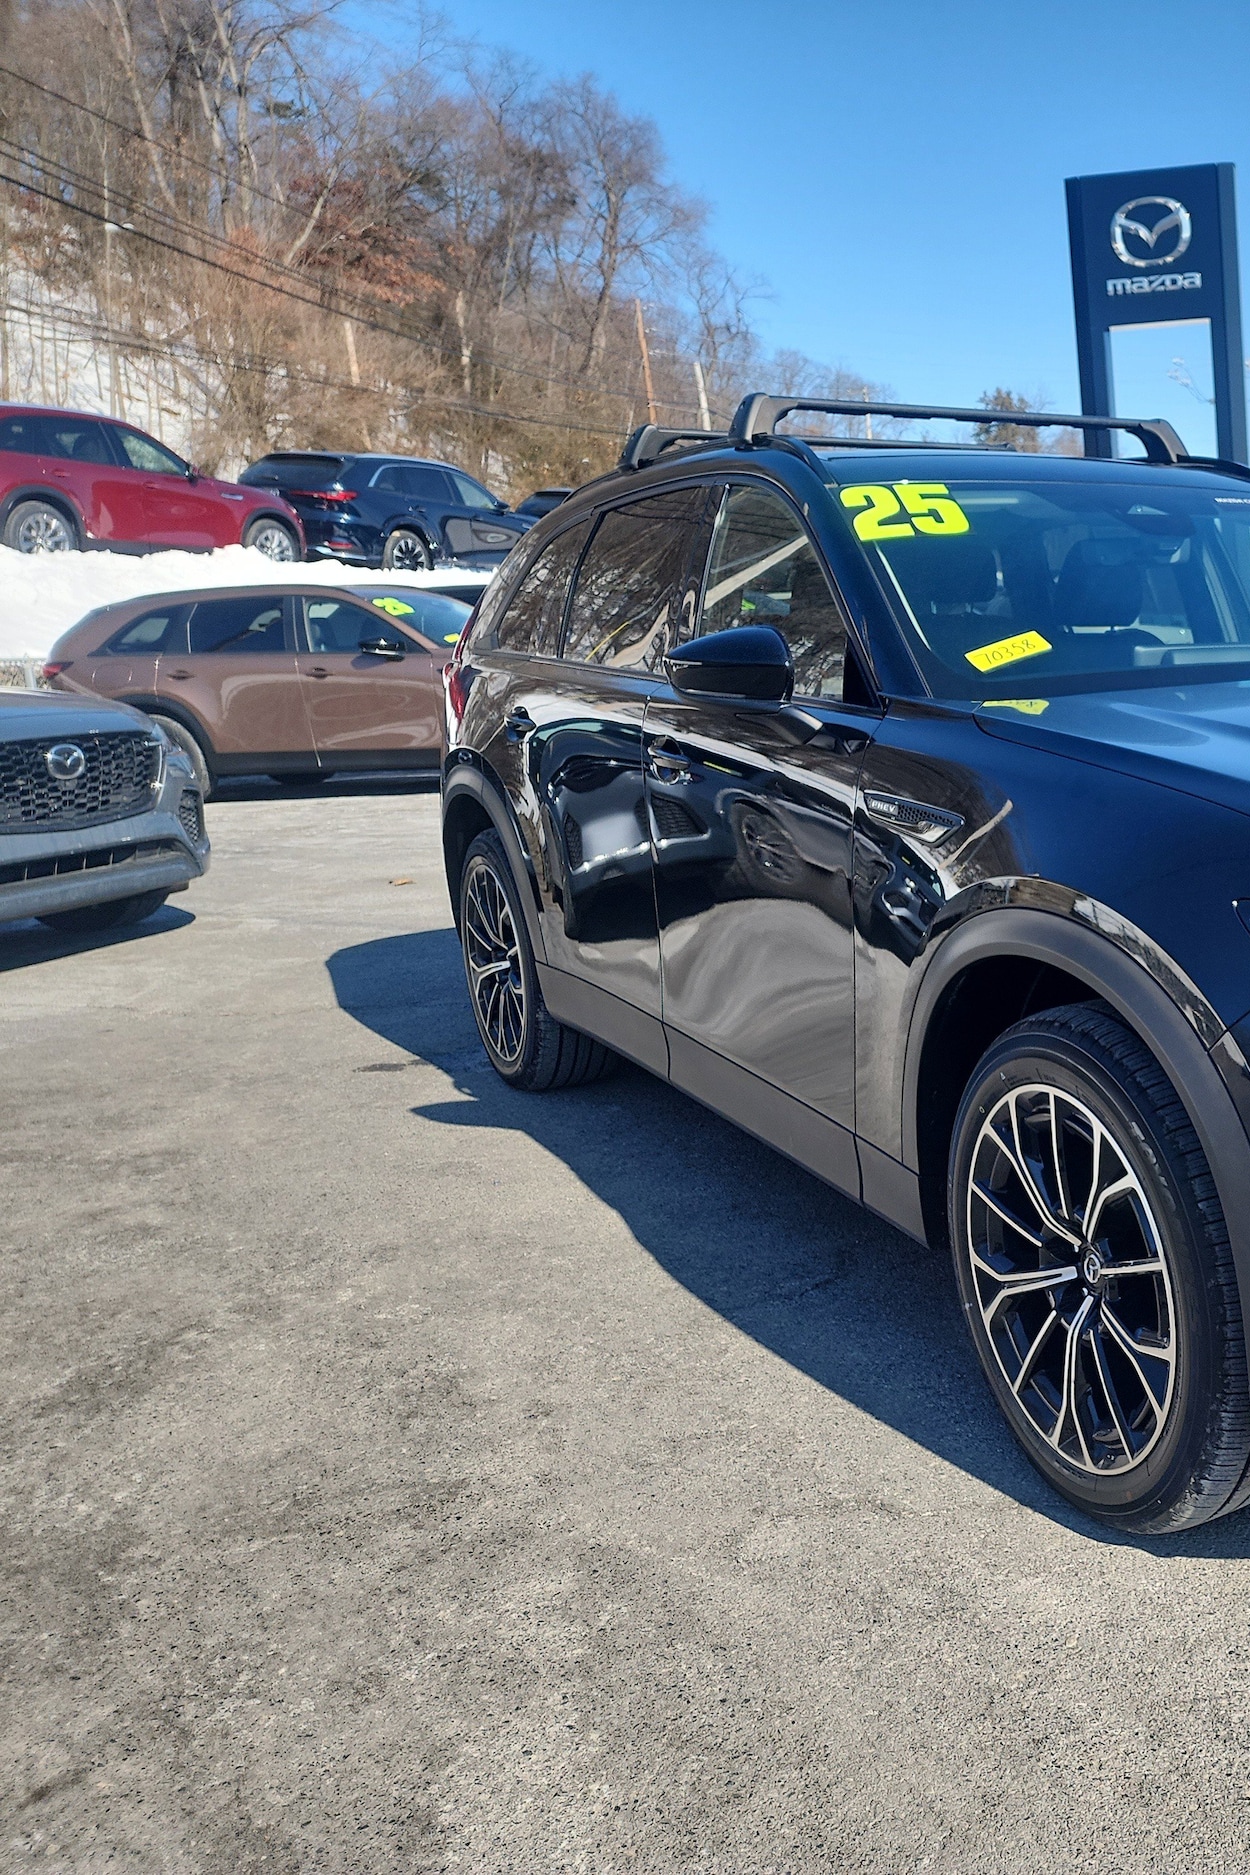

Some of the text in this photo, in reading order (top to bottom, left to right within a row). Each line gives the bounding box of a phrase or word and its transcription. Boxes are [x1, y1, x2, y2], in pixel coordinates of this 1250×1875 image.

[839, 483, 970, 541] 25
[974, 639, 1036, 665] 70358
[871, 800, 896, 812] PHEV
